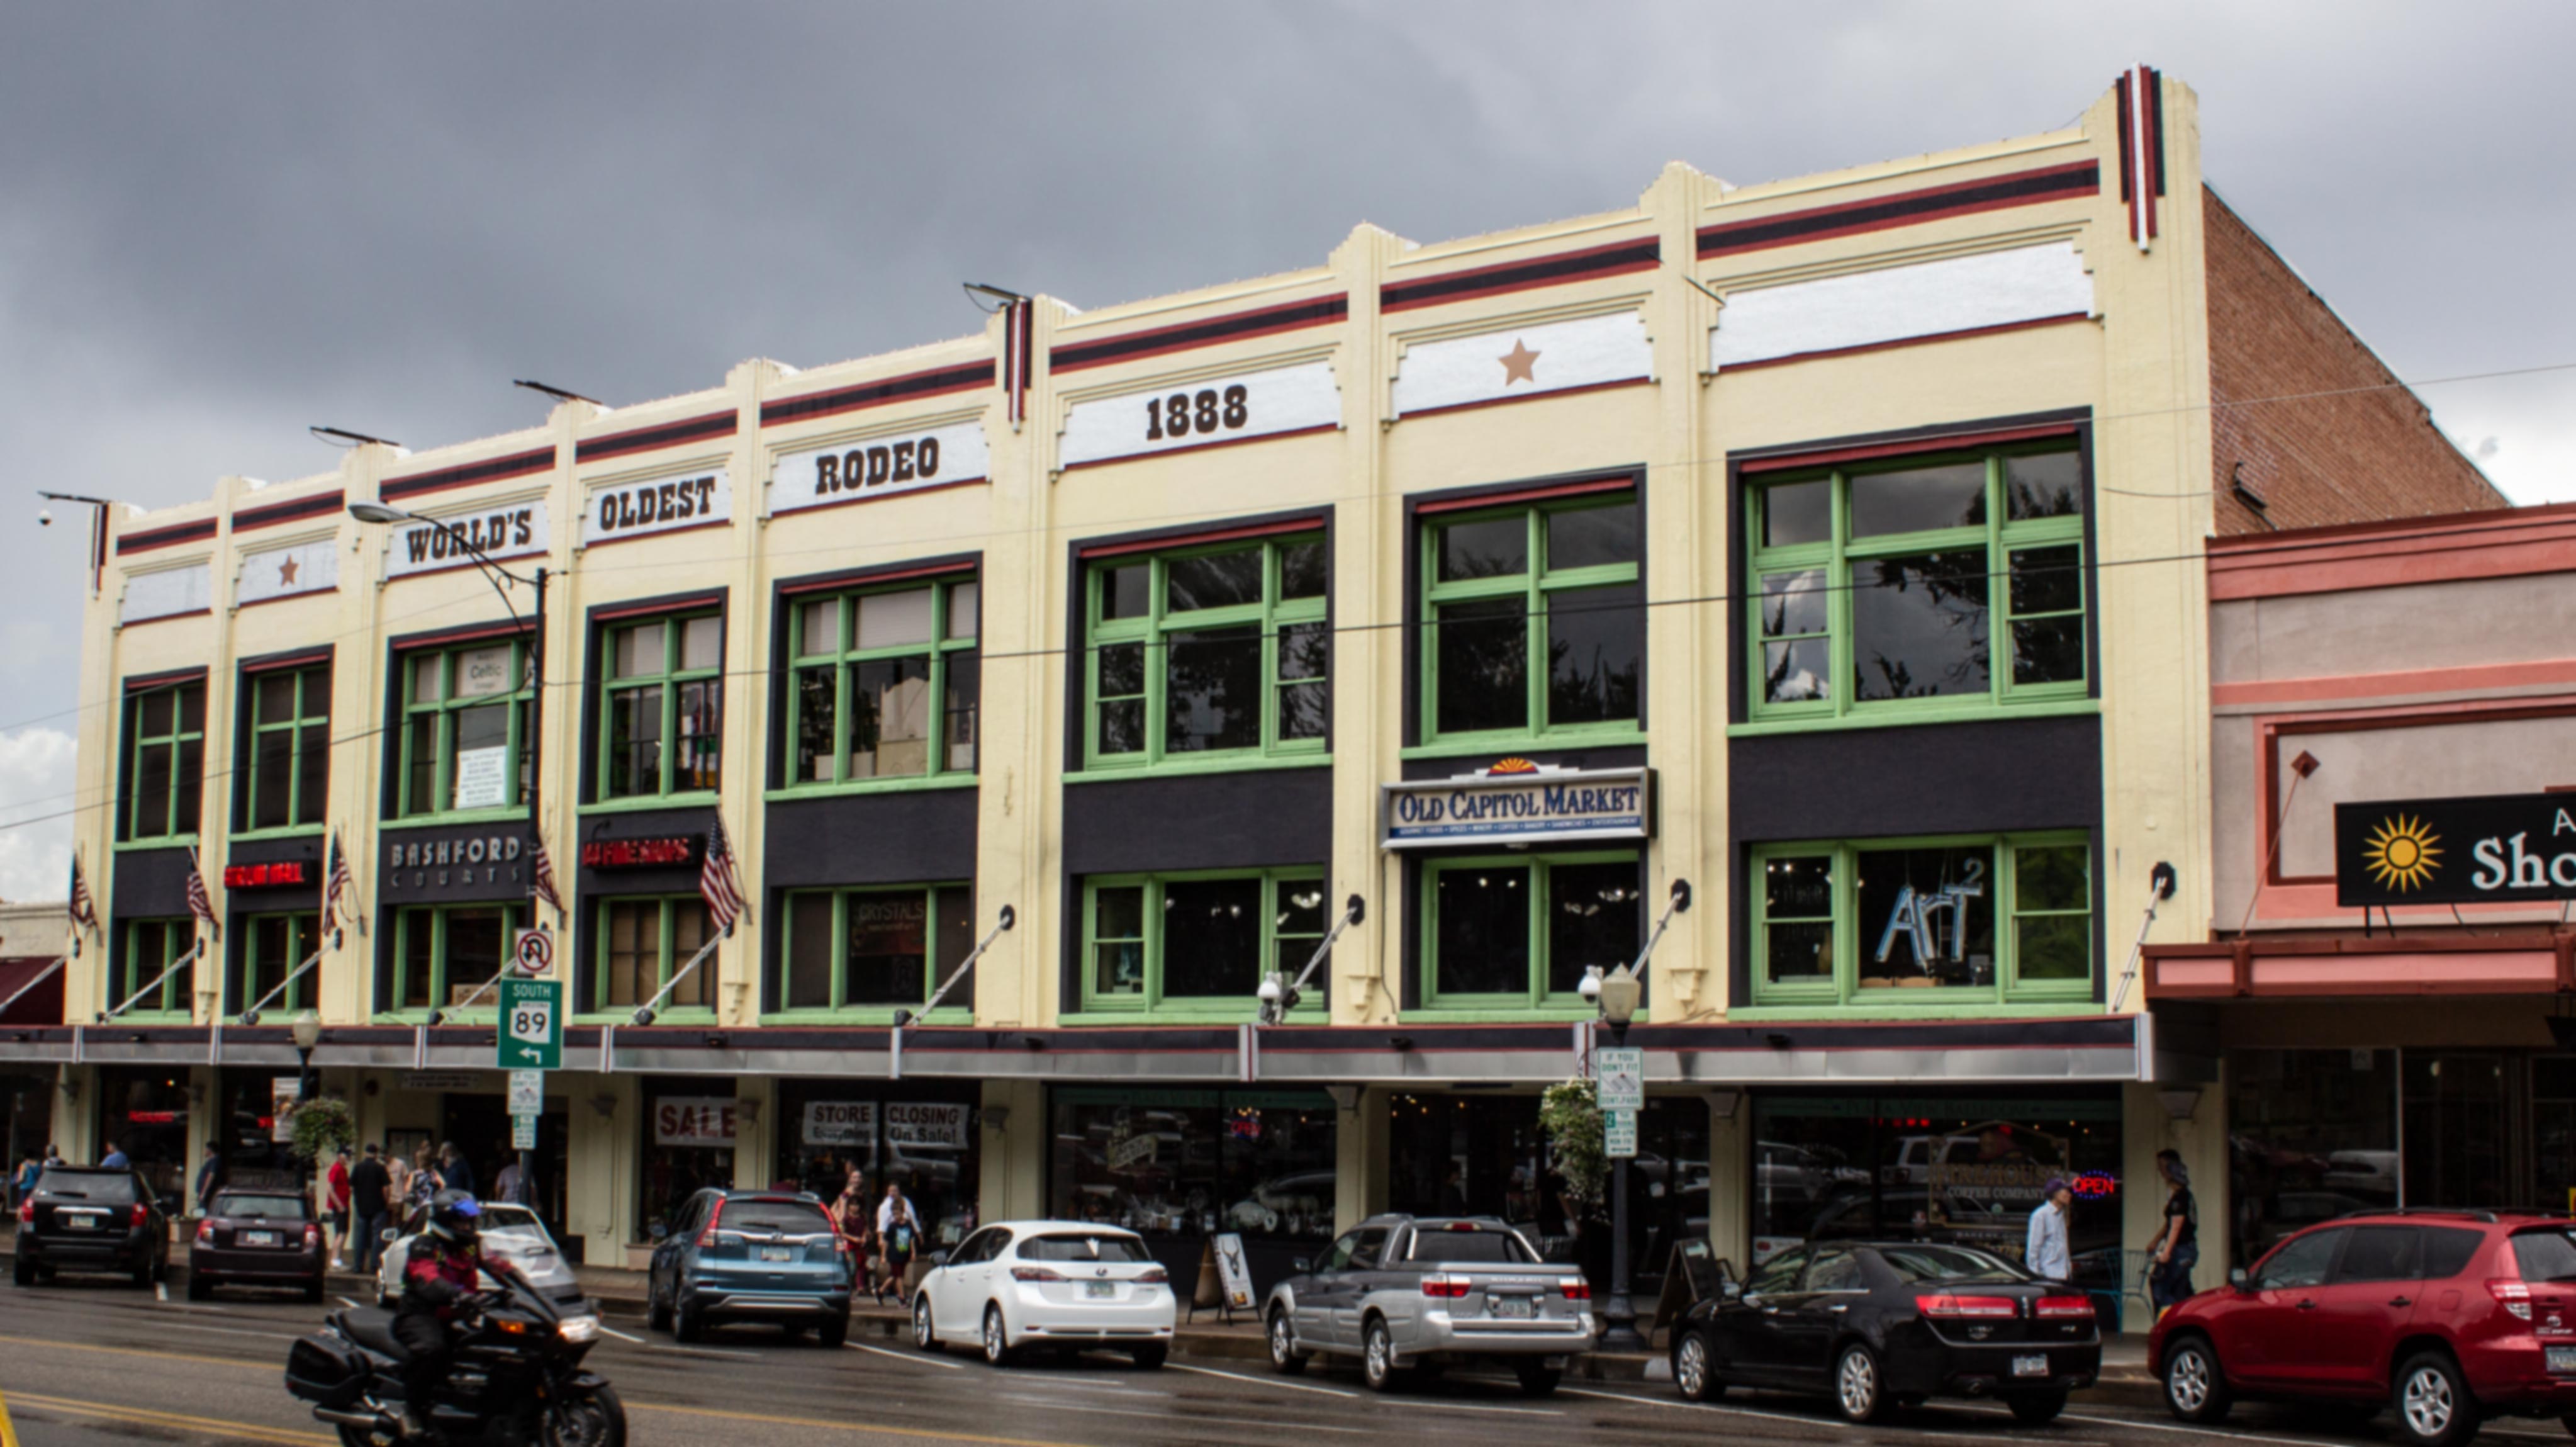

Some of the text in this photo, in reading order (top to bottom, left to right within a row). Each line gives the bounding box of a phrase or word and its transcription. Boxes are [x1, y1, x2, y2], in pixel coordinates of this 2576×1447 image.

[1146, 385, 1248, 441] 1888
[815, 437, 939, 494] RODEO
[599, 476, 715, 531] OLDEST
[406, 509, 532, 563] WORLD'S
[1399, 785, 1639, 822] OLD CAPITOL MARKET
[391, 836, 520, 867] BASHFORD
[391, 867, 518, 887] COURTS
[859, 901, 924, 921] CRYSTALS
[512, 984, 551, 998] SOUTH
[515, 1011, 546, 1034] 89
[1618, 1053, 1634, 1061] YOU
[660, 1105, 736, 1138] SALE
[814, 1106, 959, 1124] STORE CLOSING
[891, 1127, 912, 1141] On
[918, 1127, 956, 1144] Sale!
[1232, 1120, 1261, 1137] OPEN
[1947, 1186, 2046, 1200] COFFEE COMPANY
[2073, 1176, 2114, 1193] OPEN
